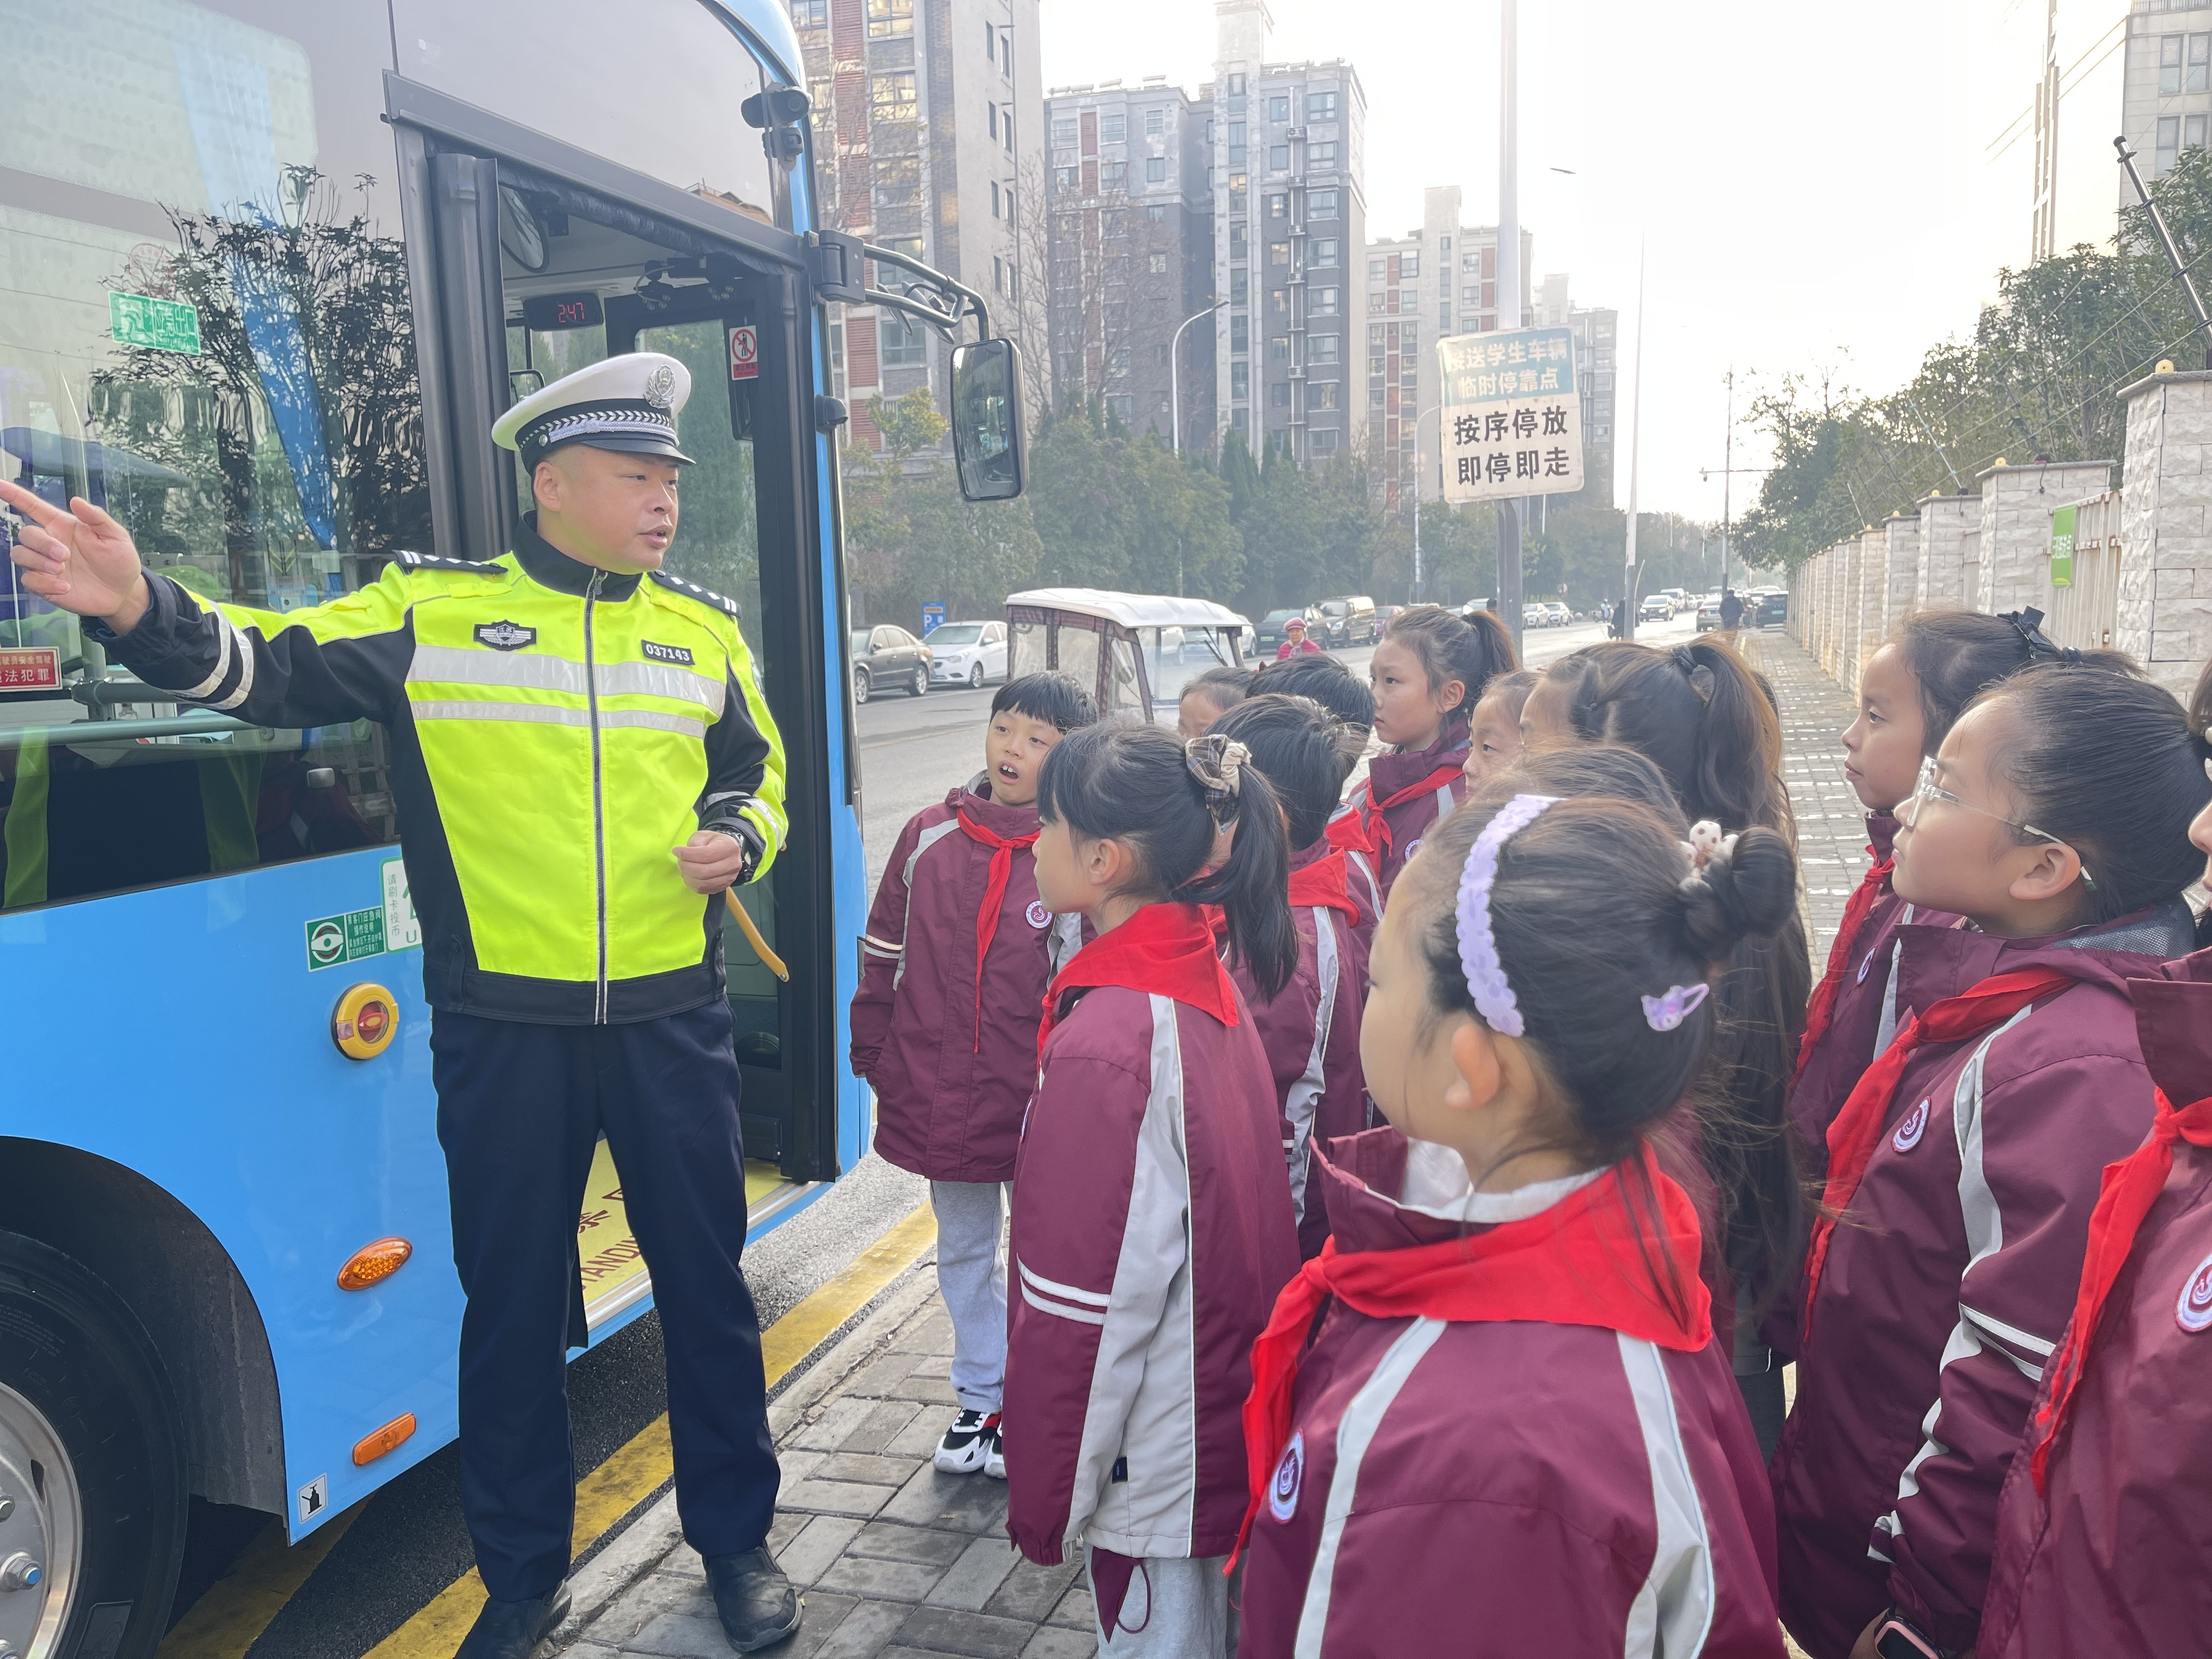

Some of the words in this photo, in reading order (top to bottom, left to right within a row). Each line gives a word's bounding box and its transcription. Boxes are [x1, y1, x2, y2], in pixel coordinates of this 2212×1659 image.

[1448, 337, 1567, 370] 接送学生车辆
[1457, 366, 1559, 399] 临时停靠点
[1454, 405, 1568, 446] 按序停放
[1457, 446, 1570, 486] 即停即走
[924, 614, 932, 628] P
[0, 655, 52, 665] 驶员安全驾驶
[646, 644, 690, 662] 037143
[0, 668, 50, 682] 法犯罪
[387, 874, 400, 936] 请刷卡投币
